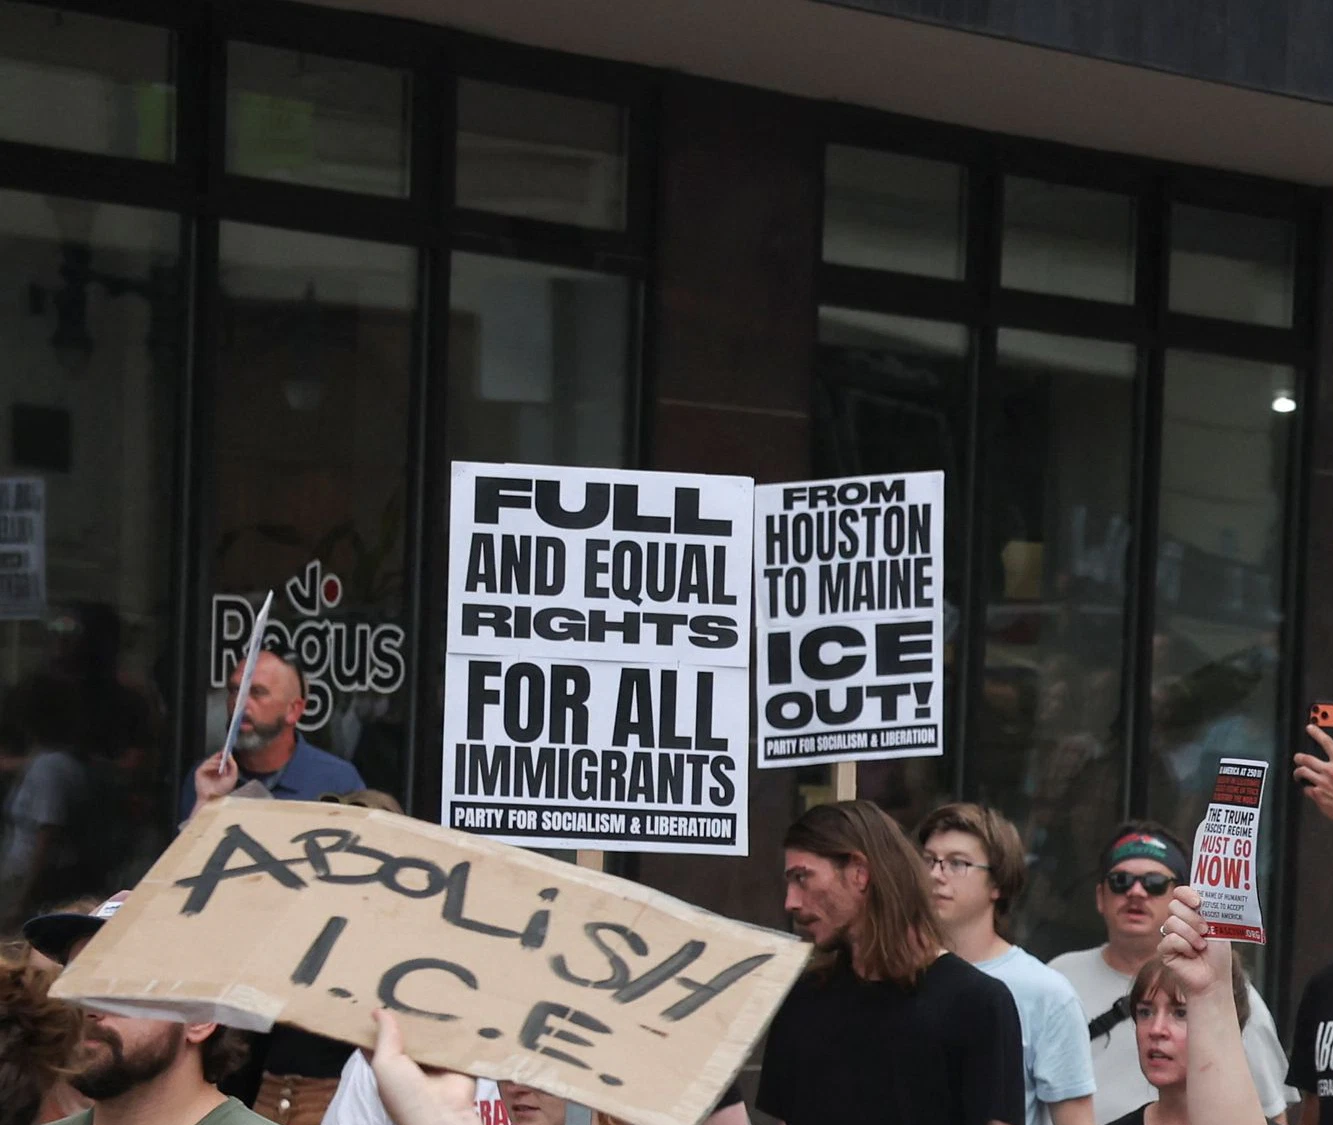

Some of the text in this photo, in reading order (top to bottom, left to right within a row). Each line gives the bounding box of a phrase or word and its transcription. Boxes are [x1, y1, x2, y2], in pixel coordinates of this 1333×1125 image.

[474, 476, 732, 537] FULL
[783, 480, 907, 510] FROM
[765, 504, 931, 565] HOUSTON
[466, 533, 737, 606] AND EQUAL
[764, 558, 933, 619] TO MAINE
[461, 604, 738, 648] RIGHTS
[767, 621, 933, 685] ICE
[466, 660, 728, 752] FOR ALL
[765, 682, 934, 730] OUT!
[766, 739, 797, 756] PARTY
[799, 737, 815, 754] FOR
[817, 732, 866, 752] SOCIALISM
[881, 727, 935, 747] LIBERATION
[454, 744, 736, 807] IMMIGRANTS
[454, 808, 732, 839] PARTY FOR SOCIALISM & LIBERATION
[1204, 823, 1252, 838] FASCIST REGIME
[1208, 808, 1255, 826] THE TRUMP
[1200, 835, 1252, 858] MUST GO
[1194, 854, 1251, 890] NOW!
[290, 915, 624, 1088] I.C.E.
